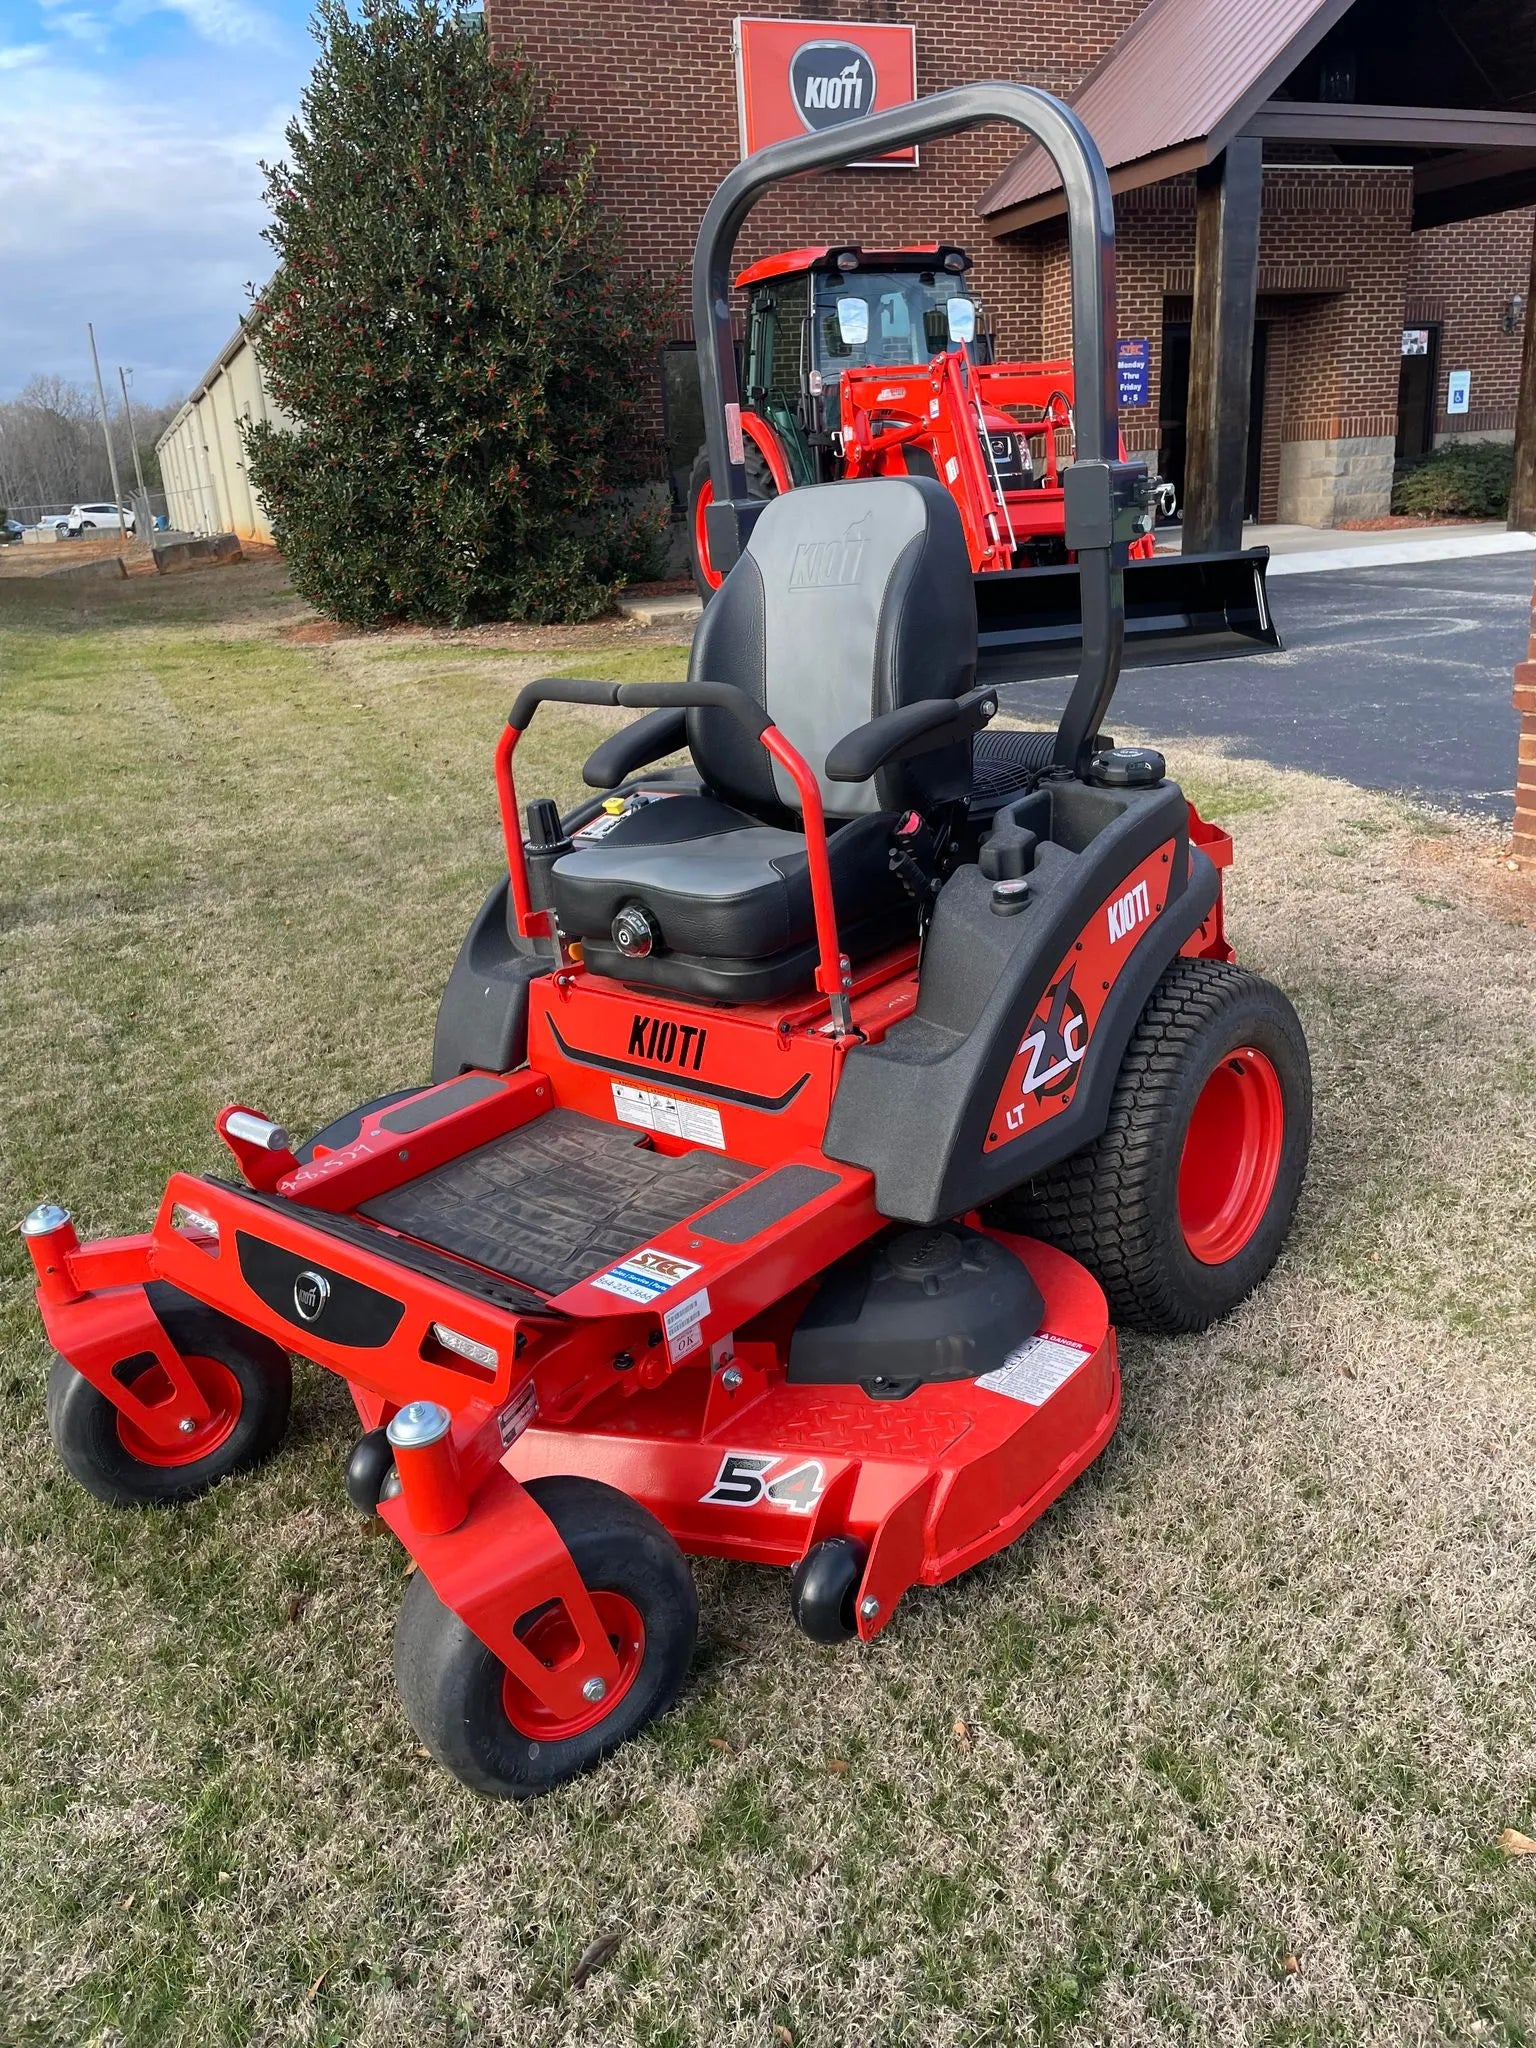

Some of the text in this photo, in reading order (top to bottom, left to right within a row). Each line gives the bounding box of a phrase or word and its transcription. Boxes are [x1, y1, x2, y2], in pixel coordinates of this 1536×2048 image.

[804, 76, 863, 109] KIOTI
[1117, 361, 1145, 369] Monday
[1122, 372, 1139, 380] Thru
[789, 539, 866, 586] KIOTI
[1107, 879, 1150, 944] KIOTI
[628, 1014, 707, 1071] KIOTI
[1006, 1102, 1025, 1130] LT
[628, 1253, 694, 1276] STEC
[610, 1268, 625, 1277] Sales
[628, 1274, 649, 1285] Service
[652, 1282, 668, 1291] Parts
[678, 1336, 694, 1351] OK
[1049, 1335, 1083, 1350] DANGER
[698, 1451, 825, 1514] 54
